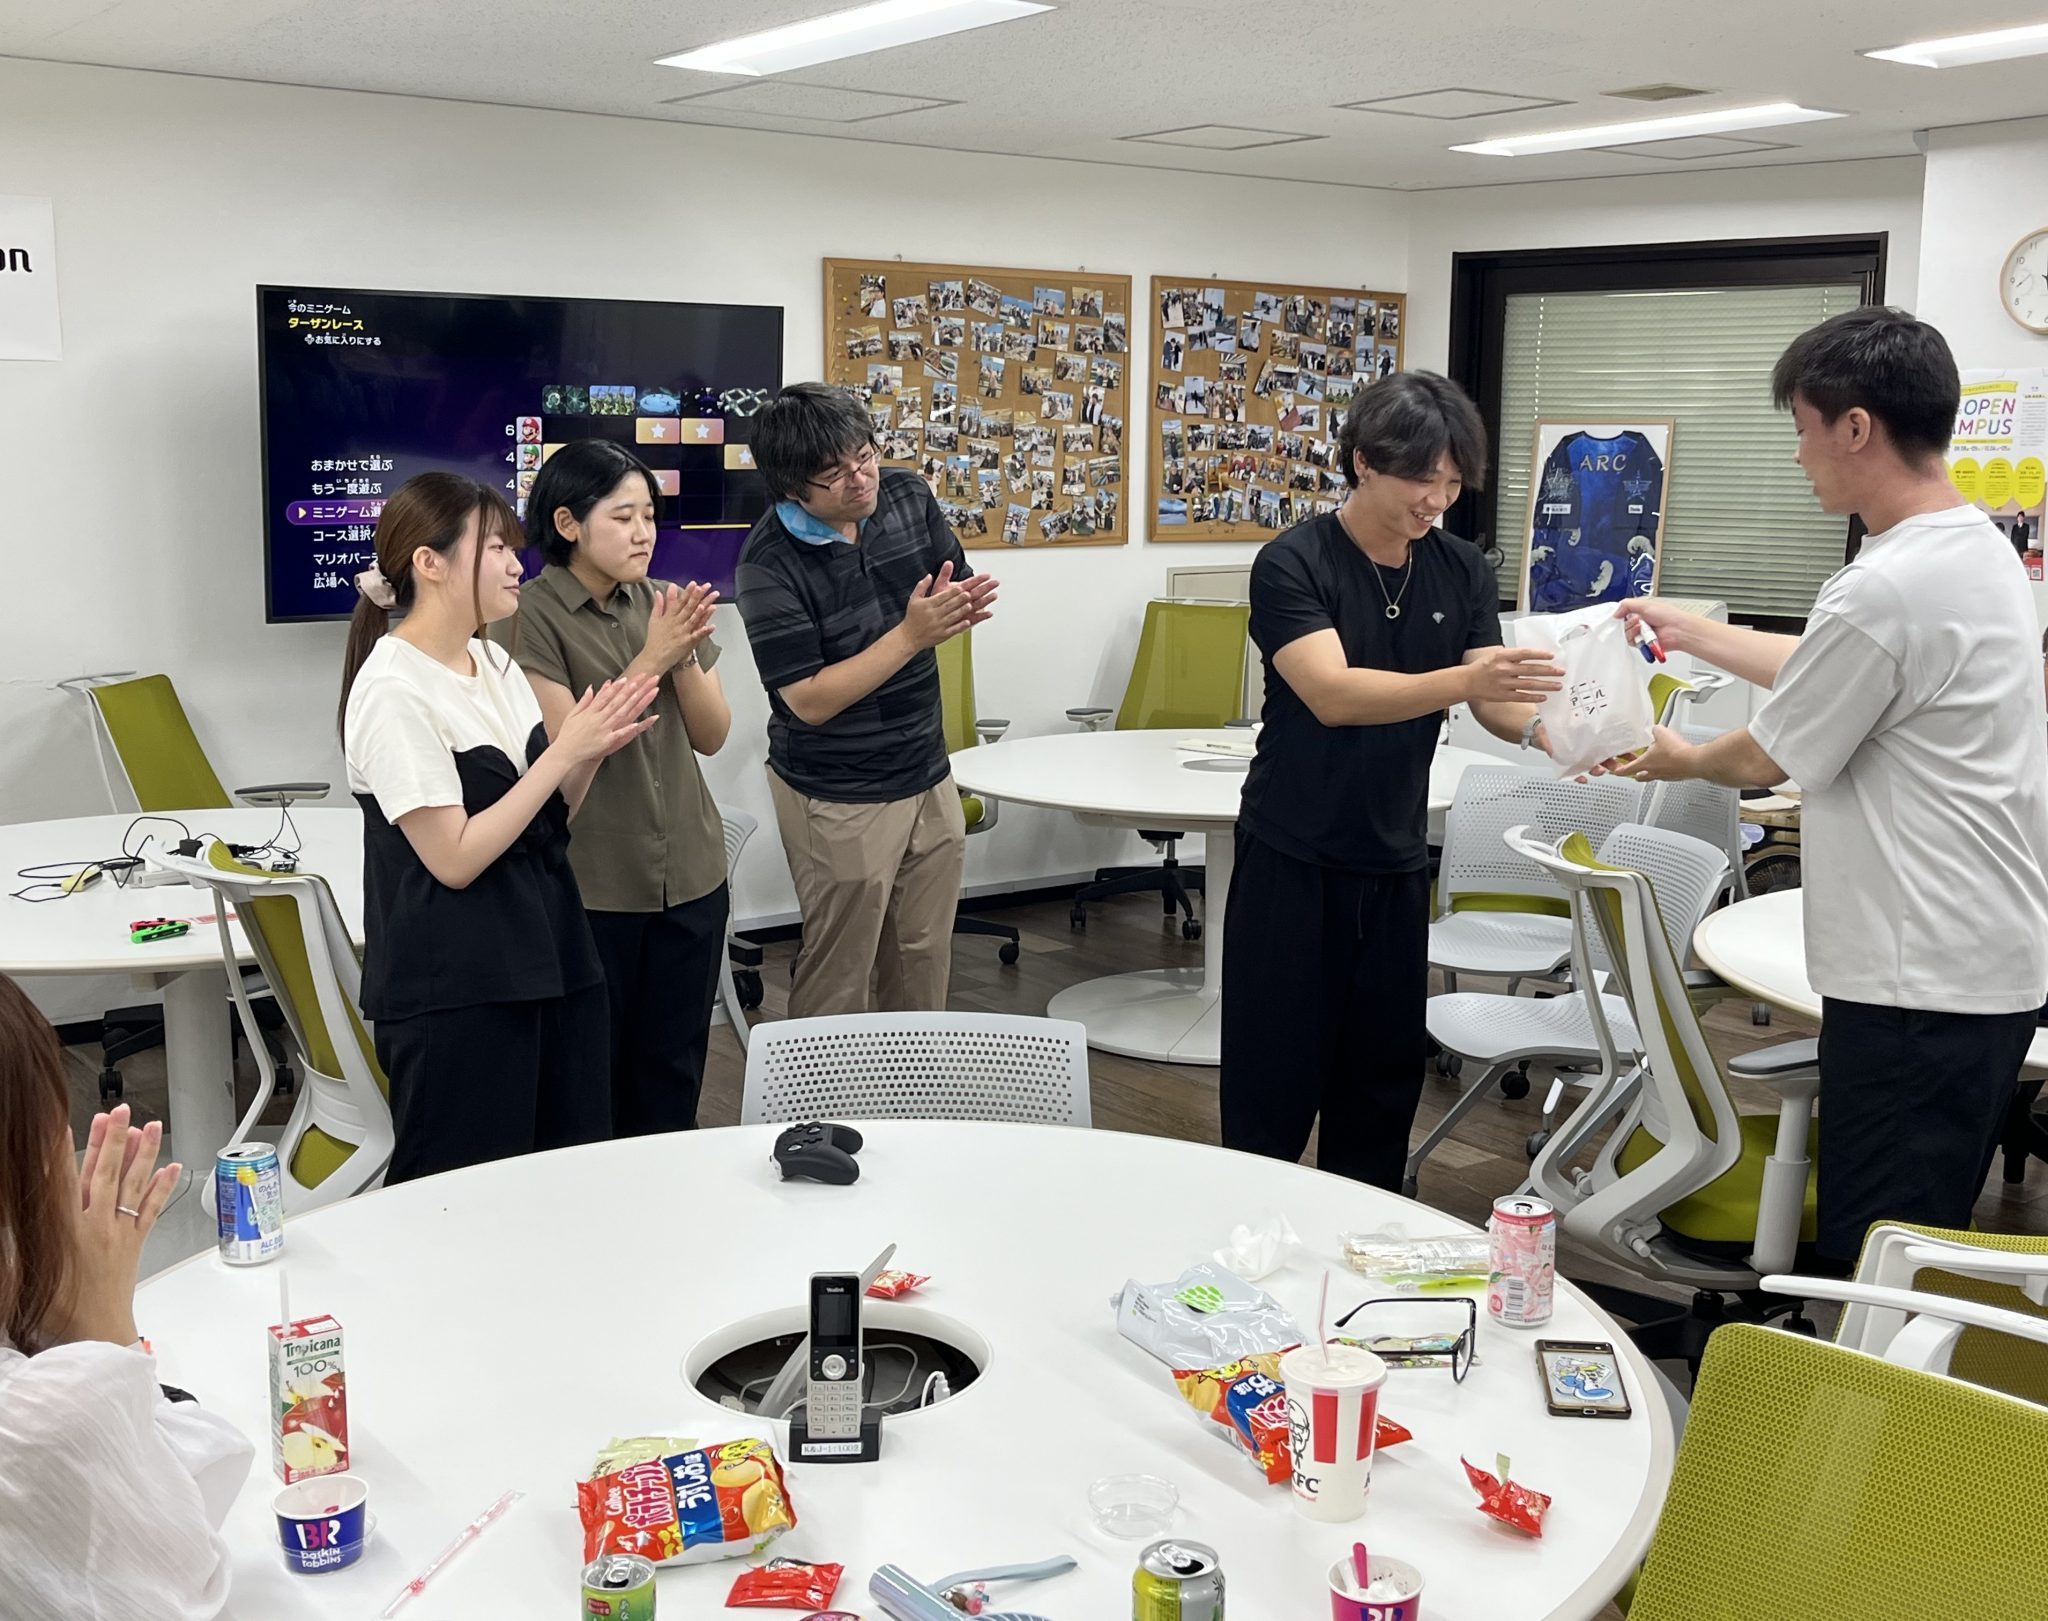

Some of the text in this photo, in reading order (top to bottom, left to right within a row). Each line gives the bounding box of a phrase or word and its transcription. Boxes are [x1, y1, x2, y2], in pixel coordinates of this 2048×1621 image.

[288, 302, 351, 314] 今のミニゲーム
[288, 317, 364, 331] ターザンレース
[315, 335, 381, 346] お気に入りにする
[1964, 399, 2016, 416] OPEN
[505, 424, 515, 436] 6
[505, 451, 515, 463] 4
[1579, 454, 1627, 472] ARC
[311, 459, 393, 471] おまかせで選ぶ
[312, 483, 382, 495] もう一度遊ぶ
[505, 478, 515, 490] 4
[313, 576, 349, 589] 広場へ
[283, 1337, 341, 1357] Tropicana
[293, 1359, 337, 1378] 100%
[604, 1485, 622, 1516] Calbee
[295, 1519, 341, 1549] BR
